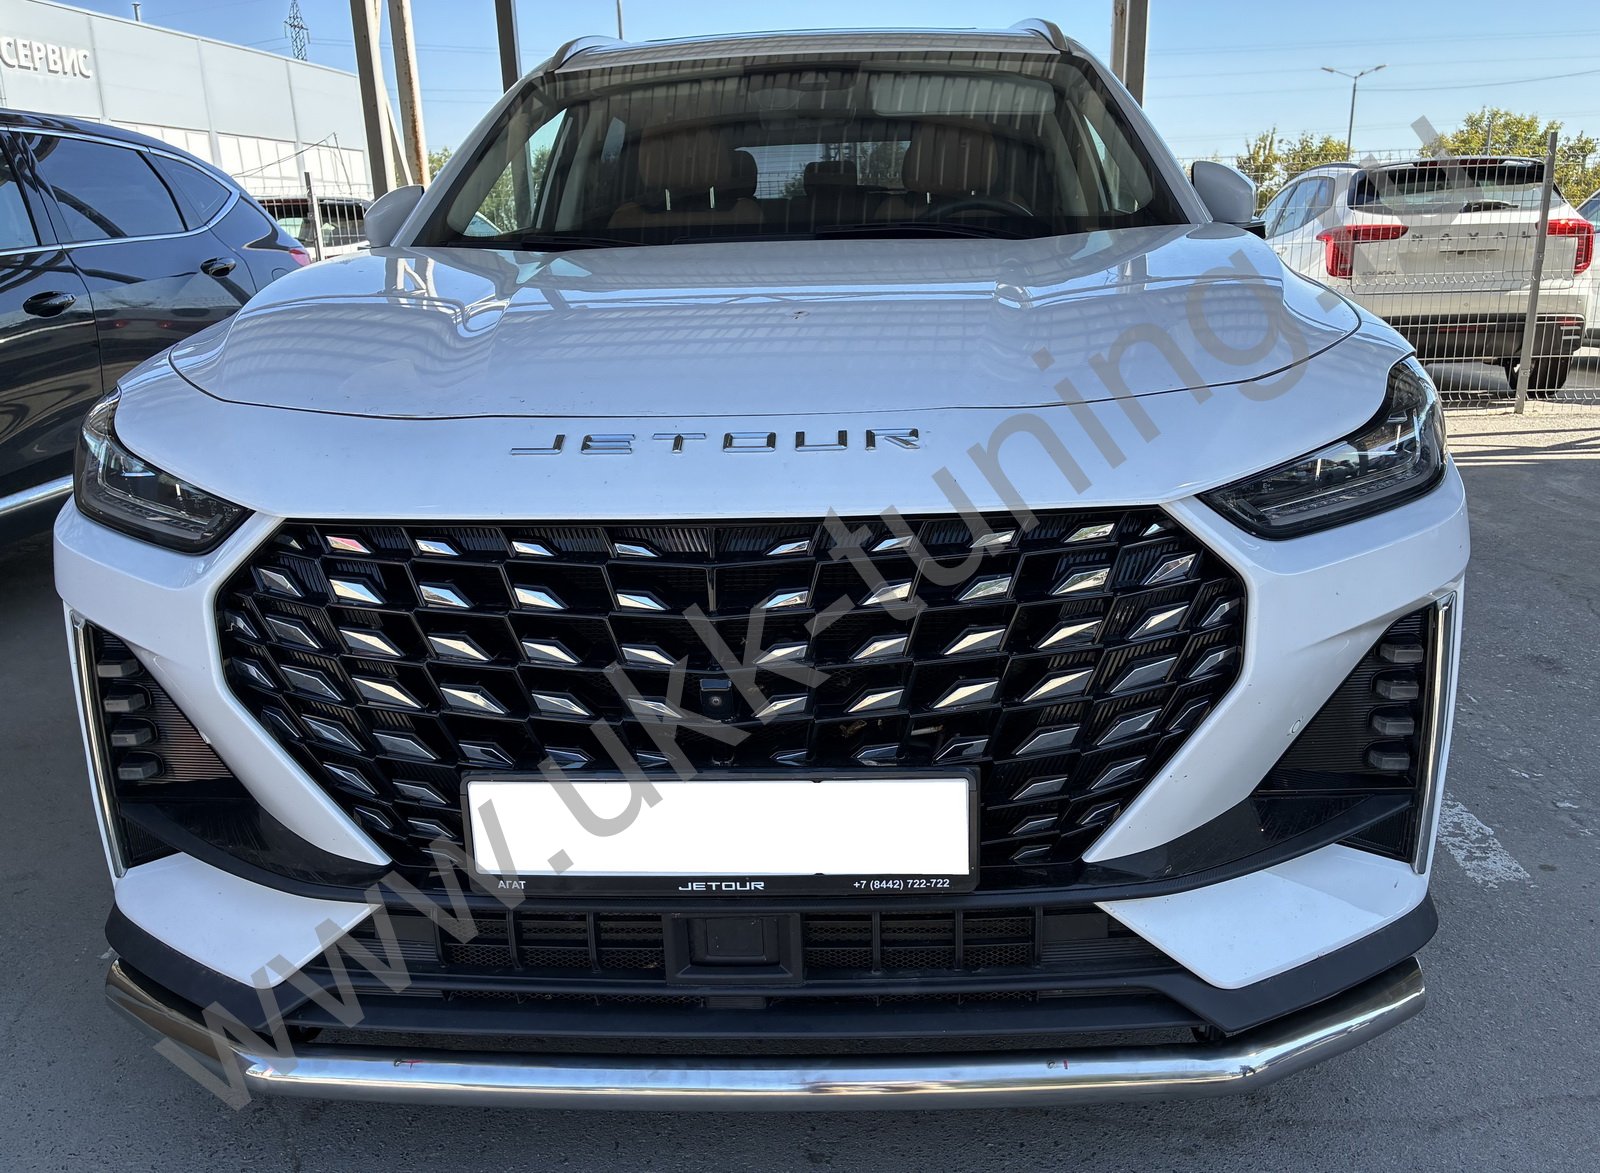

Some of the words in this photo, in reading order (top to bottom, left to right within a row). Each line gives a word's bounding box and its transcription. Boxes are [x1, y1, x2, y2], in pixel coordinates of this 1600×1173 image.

[0, 36, 93, 79] СЕРВИС
[509, 428, 920, 456] JETOUR
[678, 881, 765, 891] JETOUR
[853, 880, 867, 889] +7
[869, 879, 904, 891] (8442)
[906, 878, 950, 888] 722-722
